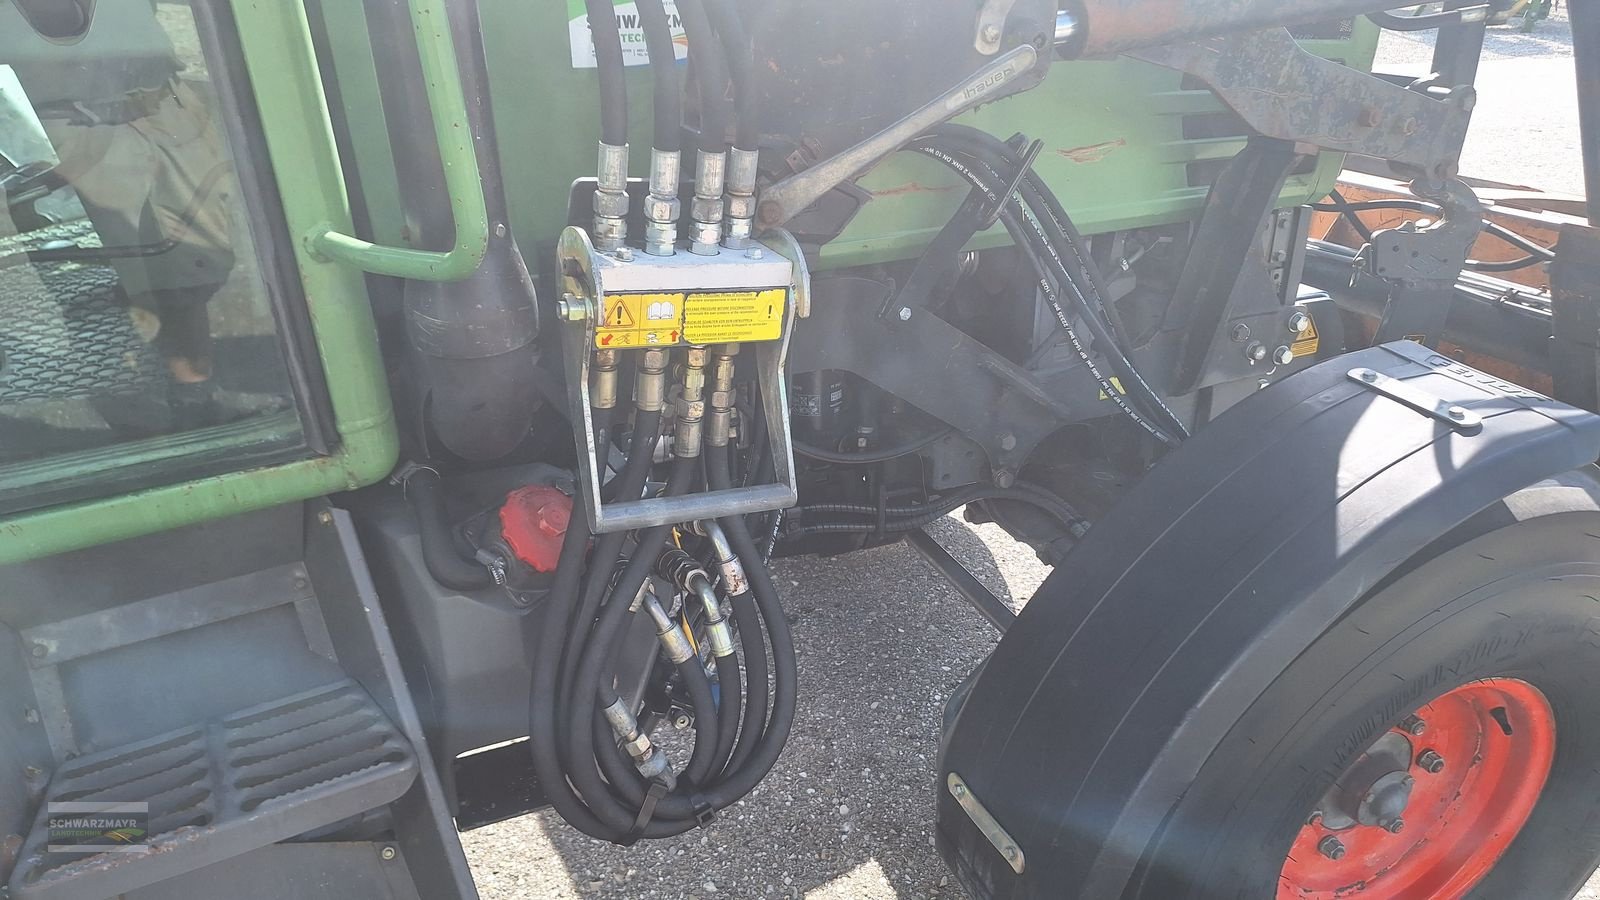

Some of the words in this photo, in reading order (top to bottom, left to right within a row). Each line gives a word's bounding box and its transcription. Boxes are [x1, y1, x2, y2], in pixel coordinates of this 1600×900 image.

[965, 171, 989, 192] premium
[1052, 301, 1061, 311] psi
[1056, 311, 1068, 327] 22335
[1067, 329, 1075, 339] bar
